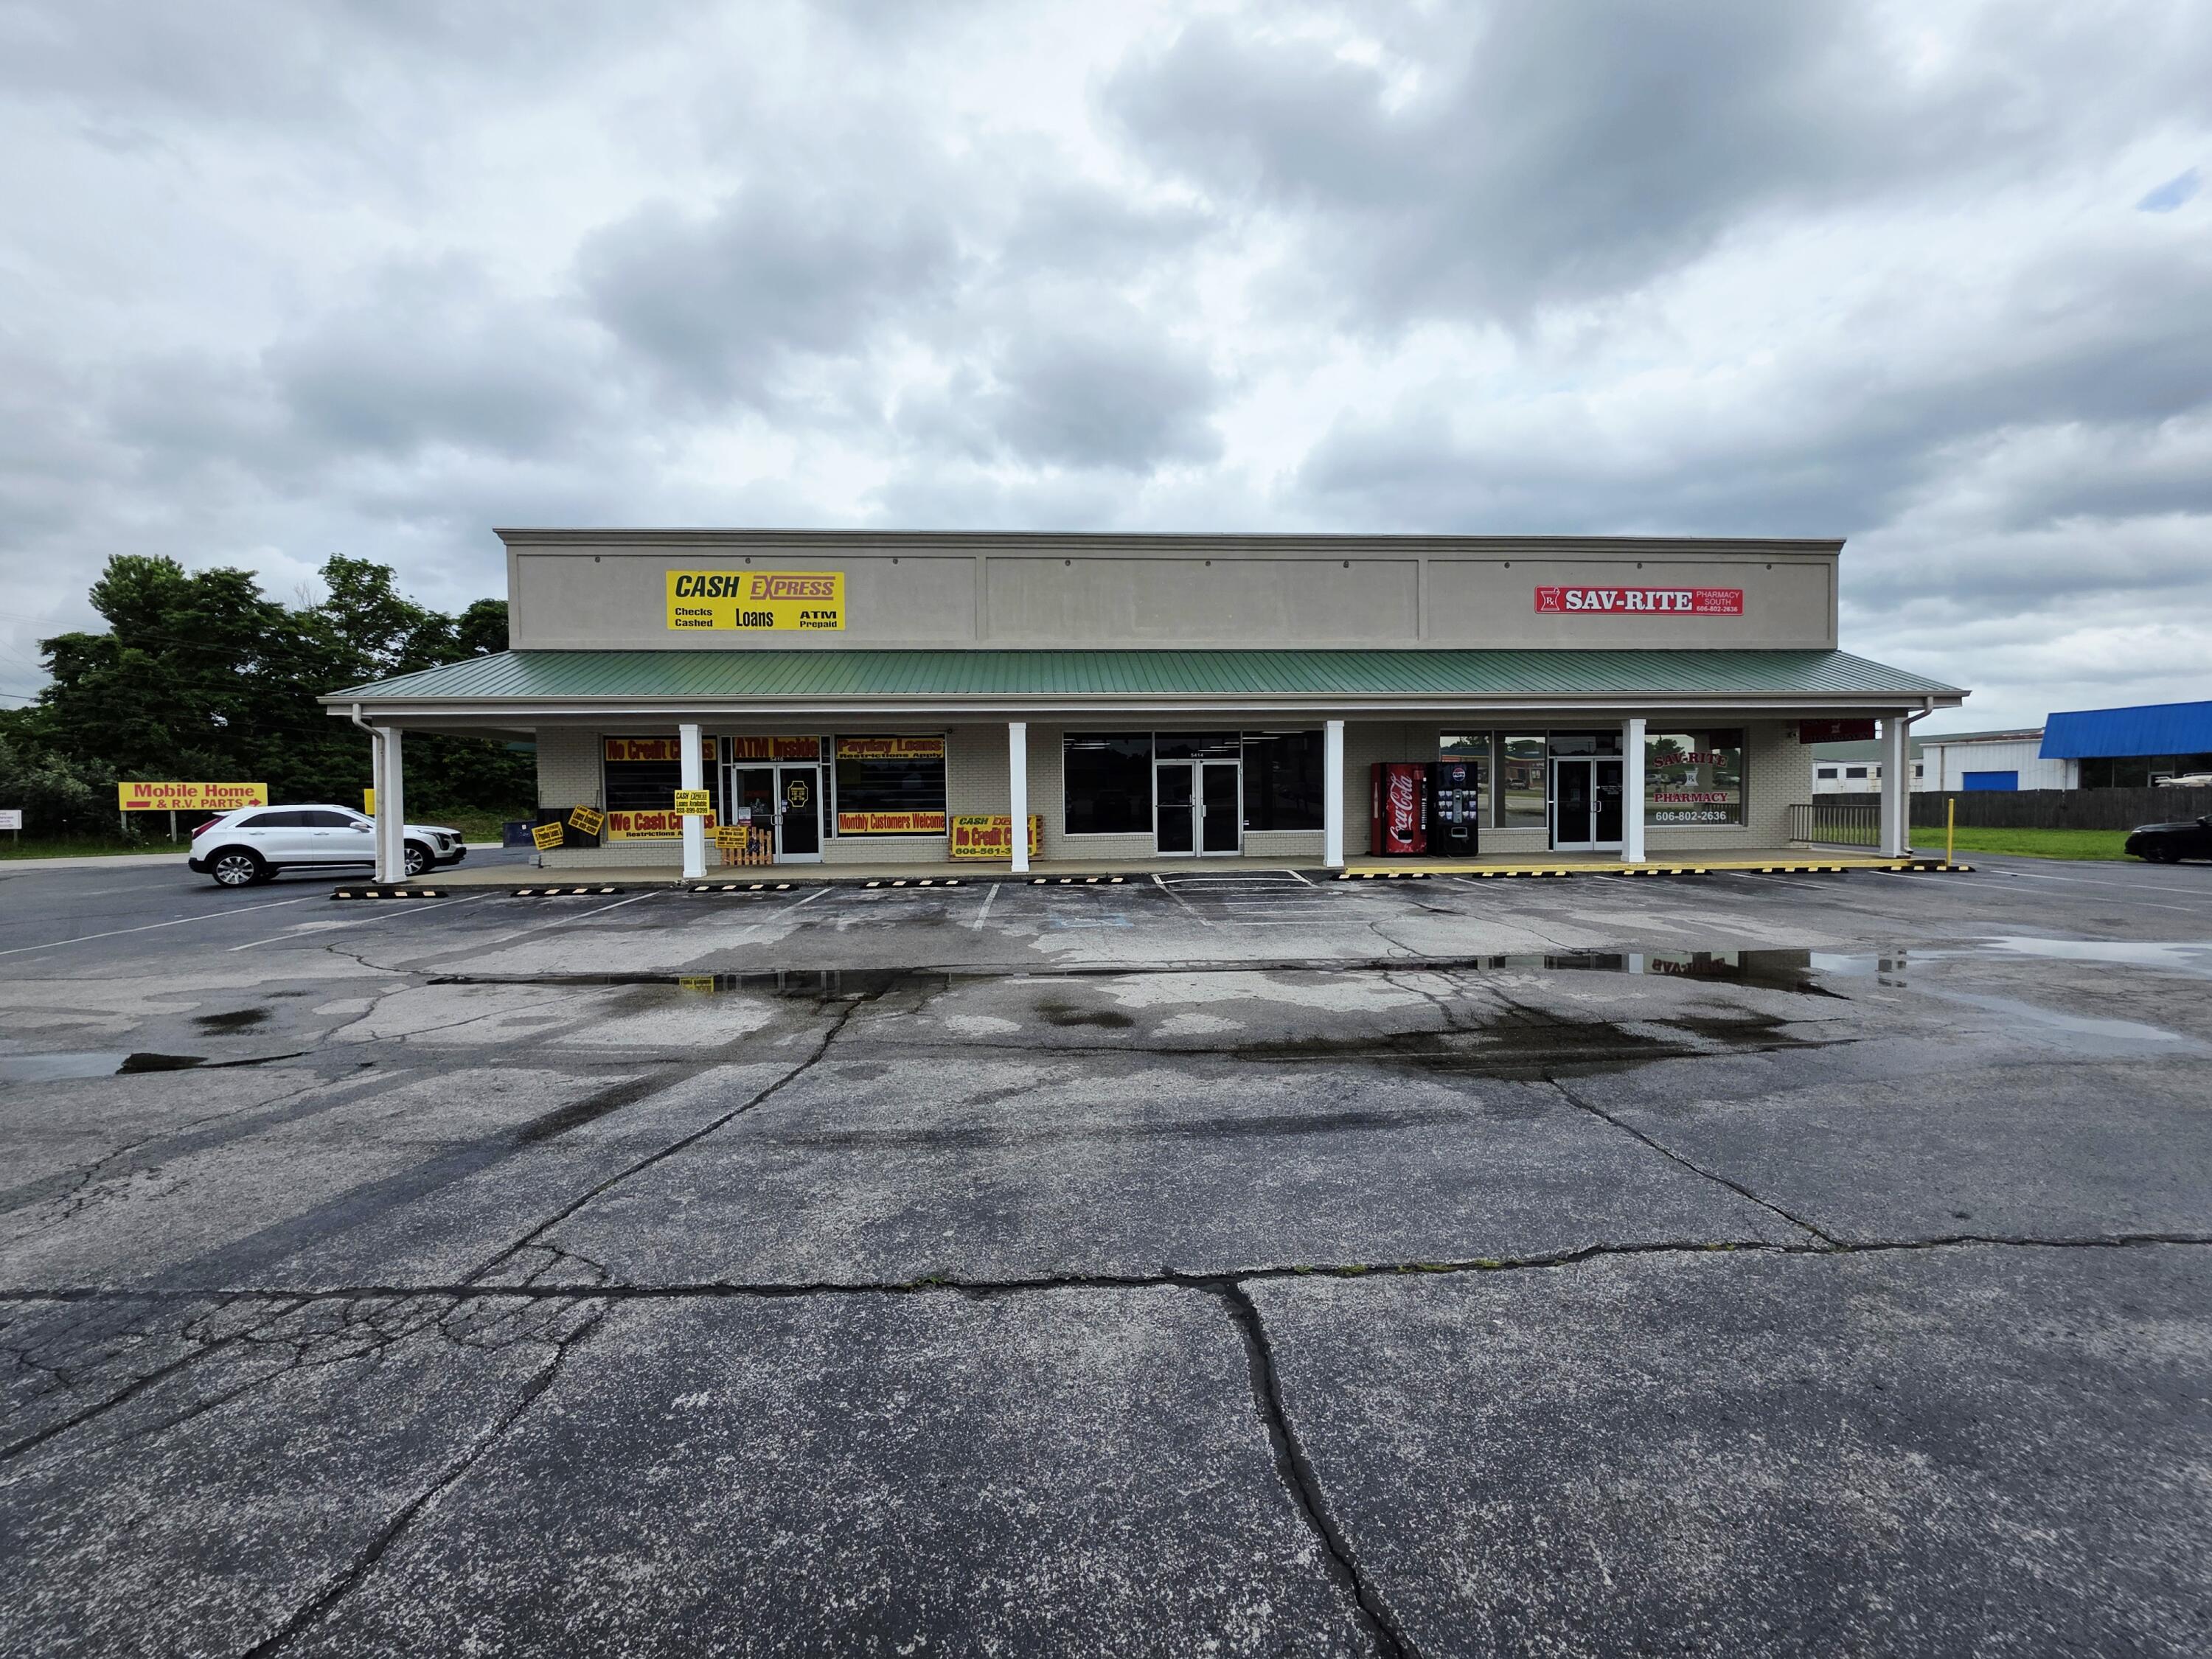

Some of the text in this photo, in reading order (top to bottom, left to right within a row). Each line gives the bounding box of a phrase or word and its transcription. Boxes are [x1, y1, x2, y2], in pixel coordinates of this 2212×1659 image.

[675, 575, 835, 600] CASH EXPRESS
[1696, 591, 1740, 599] PHARMACY
[1565, 590, 1693, 611] SAV-RITE
[675, 608, 713, 616] Checks
[736, 608, 773, 627] Loans
[800, 611, 837, 619] ATM
[675, 619, 713, 627] Cashed
[607, 740, 625, 759] No
[627, 740, 667, 759] Credit
[735, 737, 768, 758] ATM
[773, 737, 819, 758] Inside
[838, 738, 942, 754] Payday Loans
[1653, 752, 1728, 768] SAV-RITE
[134, 784, 255, 797] Mobile Home
[1653, 792, 1728, 803] PHARMACY
[156, 799, 243, 808] & R.V. PARTS
[609, 813, 631, 831] We
[634, 813, 666, 831] Cash
[839, 813, 945, 831] Monthly Customers Welcome
[959, 817, 989, 825] CASH
[1655, 811, 1727, 821] 606-802-2636
[956, 827, 970, 846] No
[971, 827, 1002, 846] Credit
